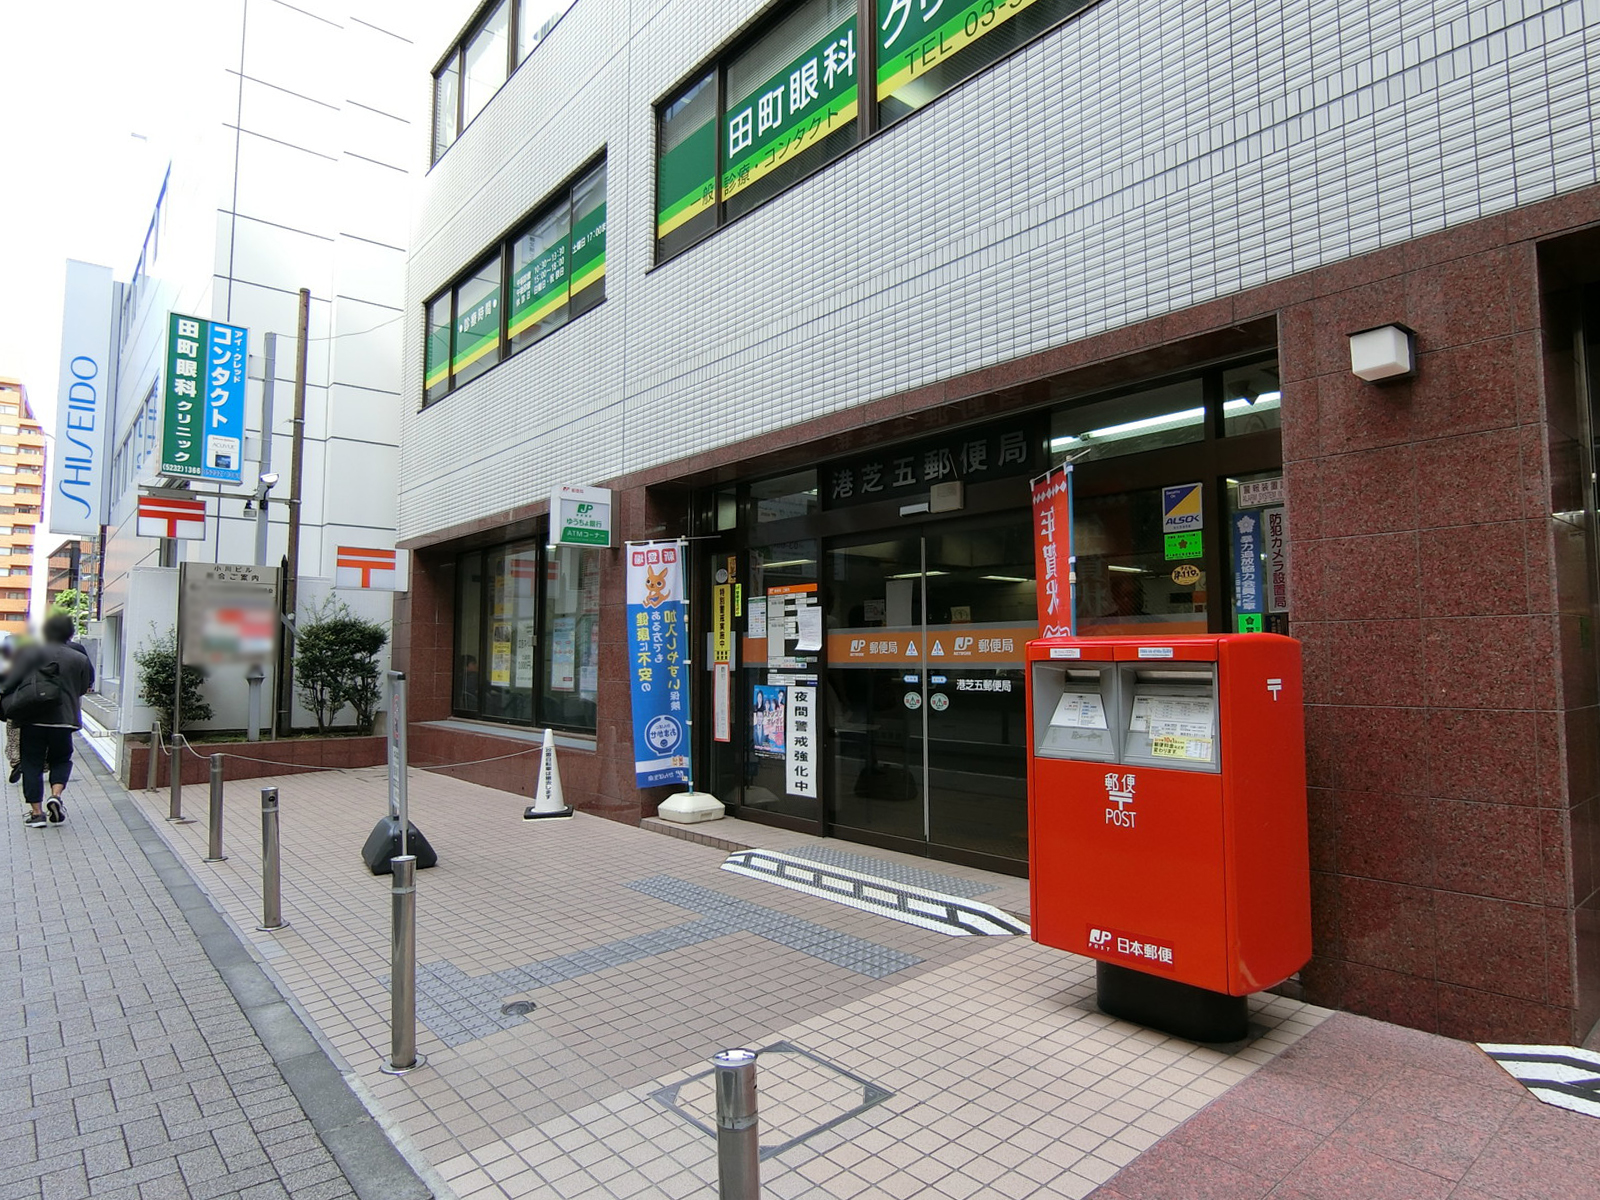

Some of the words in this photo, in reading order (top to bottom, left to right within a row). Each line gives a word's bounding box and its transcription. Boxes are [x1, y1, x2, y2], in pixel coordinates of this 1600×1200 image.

[904, 31, 953, 75] TEL
[729, 29, 856, 159] 田町眼科
[174, 318, 199, 462] 田町眼科クリニック
[210, 326, 232, 428] コンタクト
[59, 355, 98, 520] SHISEIDO
[832, 429, 1027, 500] 港芝五郵便局
[566, 518, 602, 528] ゆうちょ銀行
[566, 530, 605, 538] ATMコーナー
[1165, 514, 1200, 525] ALSOK
[1269, 513, 1287, 608] 防犯カメラ設置局
[869, 641, 898, 655] 郵便局
[978, 638, 1014, 653] 郵便局
[956, 678, 1012, 693] 港芝五郵便局
[794, 691, 809, 792] 夜間警戒強化中
[1104, 772, 1136, 794] 郵便
[1105, 808, 1137, 828] POST
[1088, 943, 1111, 951] POST
[1089, 928, 1112, 945] JP
[1117, 937, 1173, 964] 日本郵便
